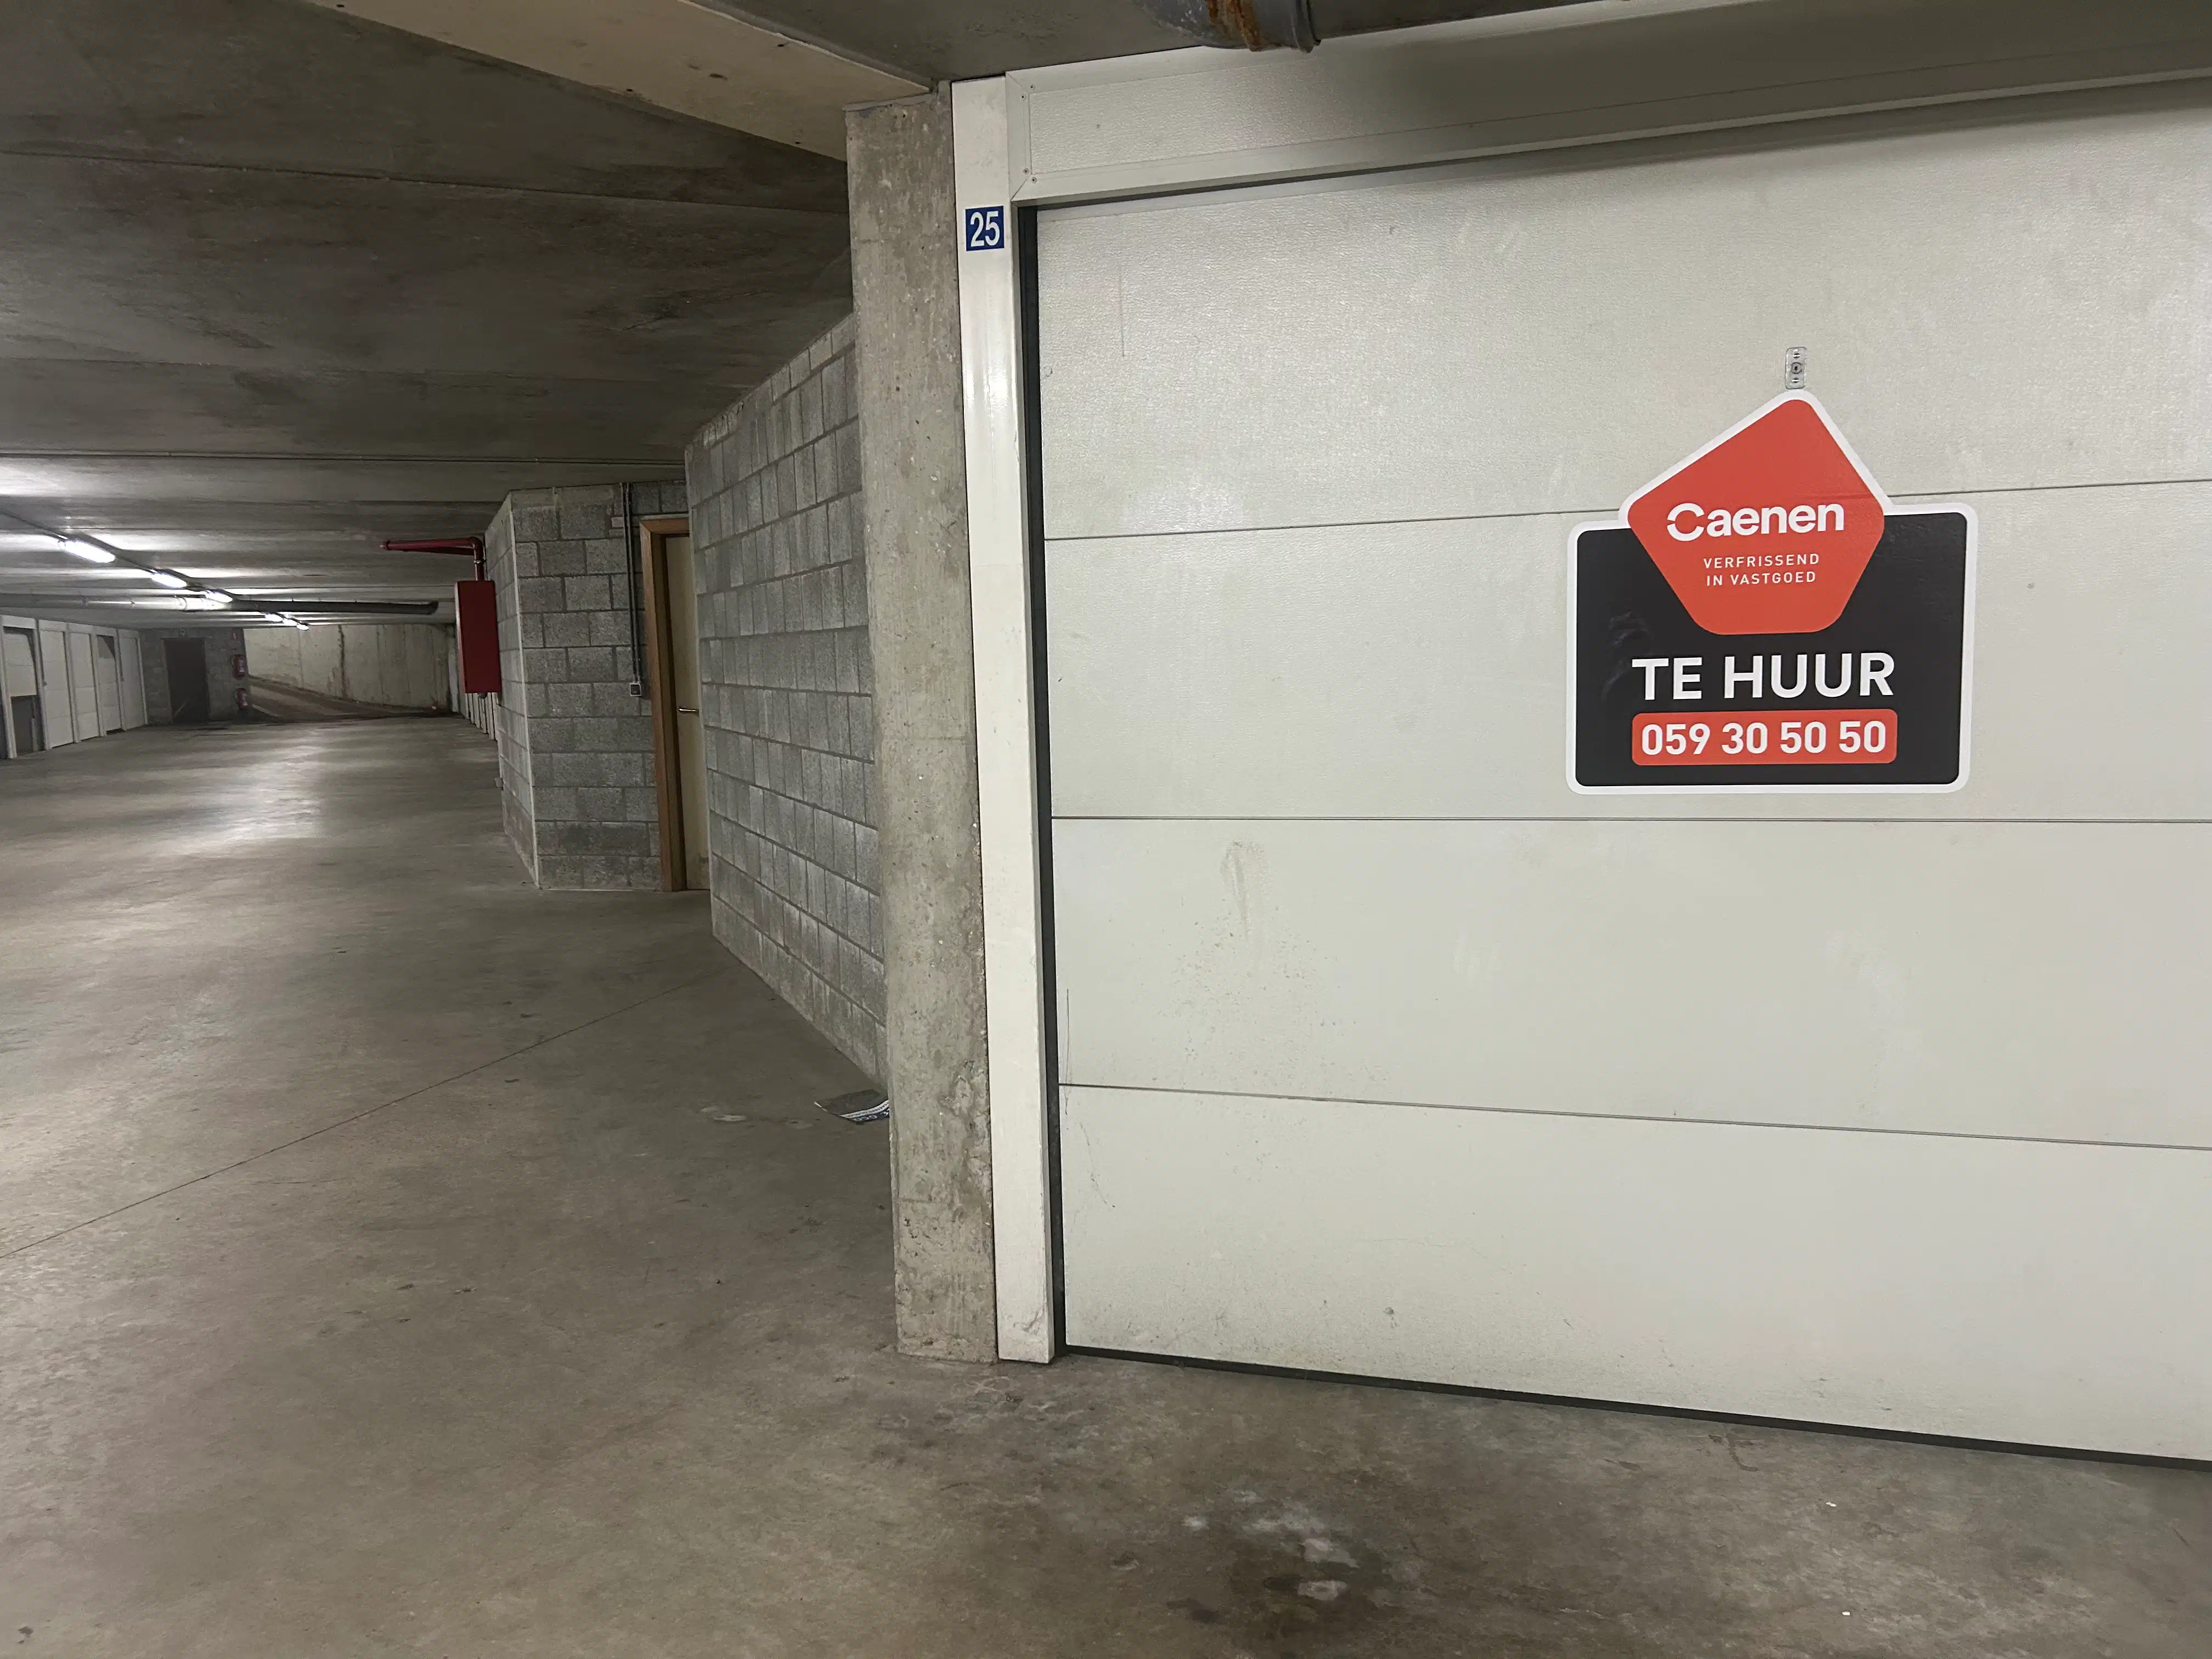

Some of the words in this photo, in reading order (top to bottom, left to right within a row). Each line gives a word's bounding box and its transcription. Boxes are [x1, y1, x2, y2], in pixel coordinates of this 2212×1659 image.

[970, 211, 1000, 247] 25
[1667, 503, 1844, 541] Caenen
[1703, 553, 1819, 569] VERFRISSEND
[1707, 574, 1723, 586] IN
[1730, 571, 1815, 585] VASTGOED
[1632, 657, 1702, 701] TE
[1724, 652, 1895, 699] HUUR
[1642, 723, 1711, 755] 059
[1722, 722, 1768, 754] 30
[1780, 721, 1827, 754] 50
[1838, 720, 1886, 753] 50
